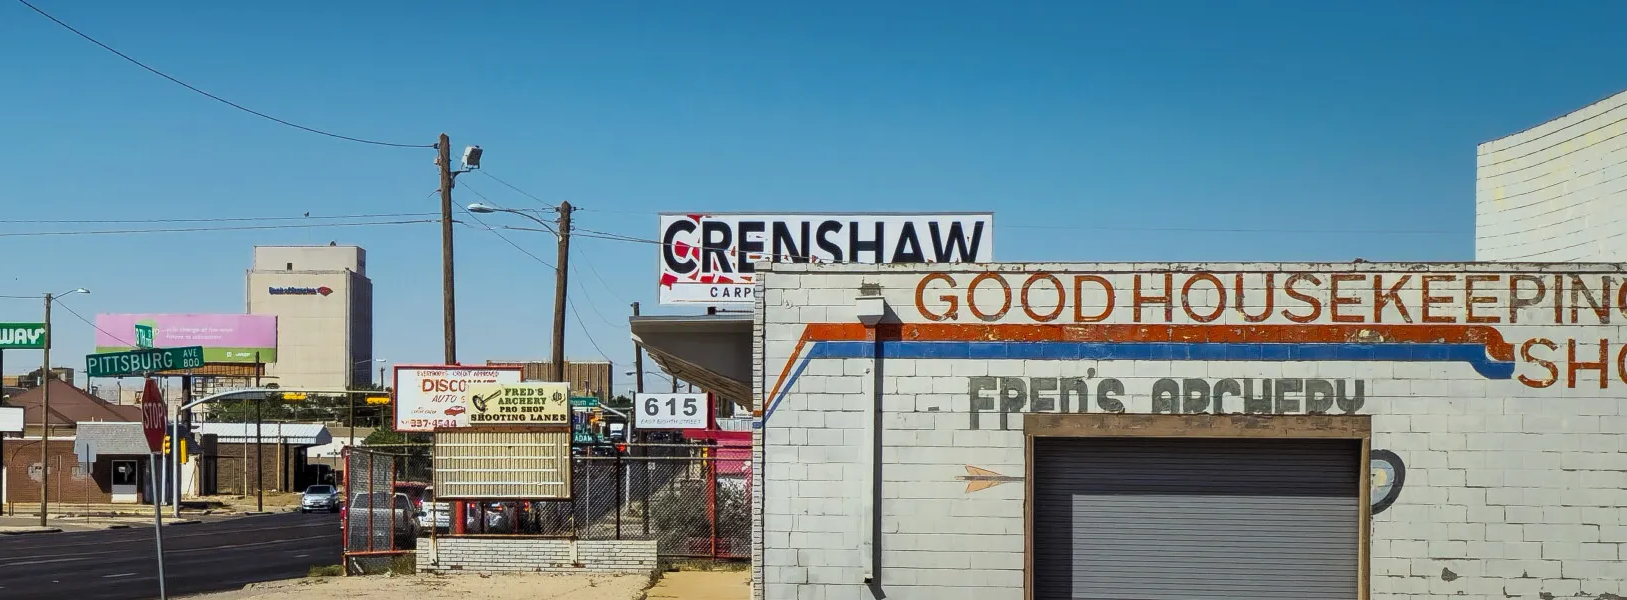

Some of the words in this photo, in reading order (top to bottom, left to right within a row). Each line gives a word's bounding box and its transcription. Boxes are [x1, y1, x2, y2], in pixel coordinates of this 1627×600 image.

[663, 220, 985, 274] CRENSHAW
[914, 272, 1115, 323] GOOD
[1133, 271, 1627, 325] HOUSEKEEPIN
[183, 348, 198, 358] AVE
[87, 351, 173, 374] PITTSBURG
[183, 358, 200, 368] 800
[1517, 337, 1627, 389] SH
[431, 394, 458, 403] AUTO
[504, 387, 544, 396] FRED'S
[498, 397, 547, 405] ARCHERY
[644, 397, 698, 417] 615
[143, 402, 164, 429] STOP
[470, 413, 526, 421] SHOOTING
[529, 413, 567, 421] LANES
